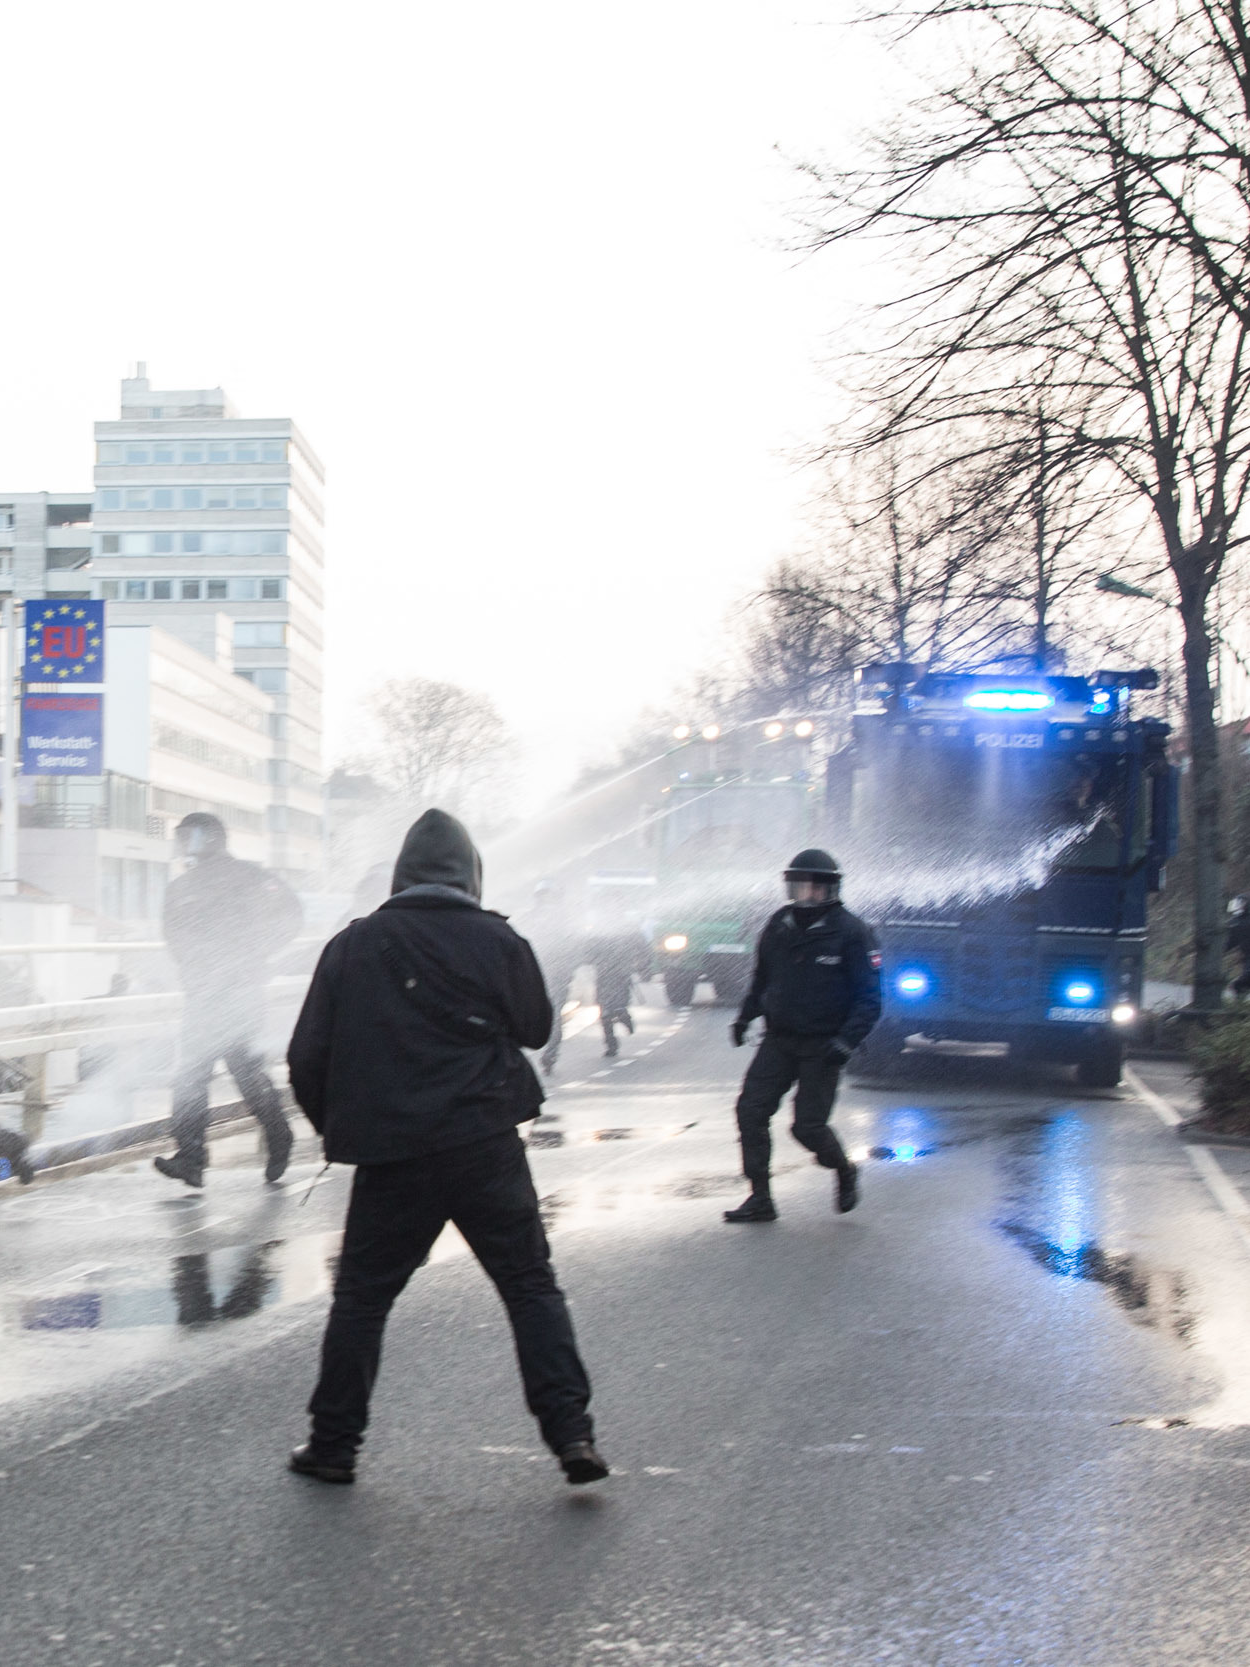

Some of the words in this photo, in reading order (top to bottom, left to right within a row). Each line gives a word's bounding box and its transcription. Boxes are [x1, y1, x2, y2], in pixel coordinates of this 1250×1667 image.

[42, 625, 87, 658] EU
[974, 733, 1044, 748] POLIZEI
[37, 753, 88, 767] Service
